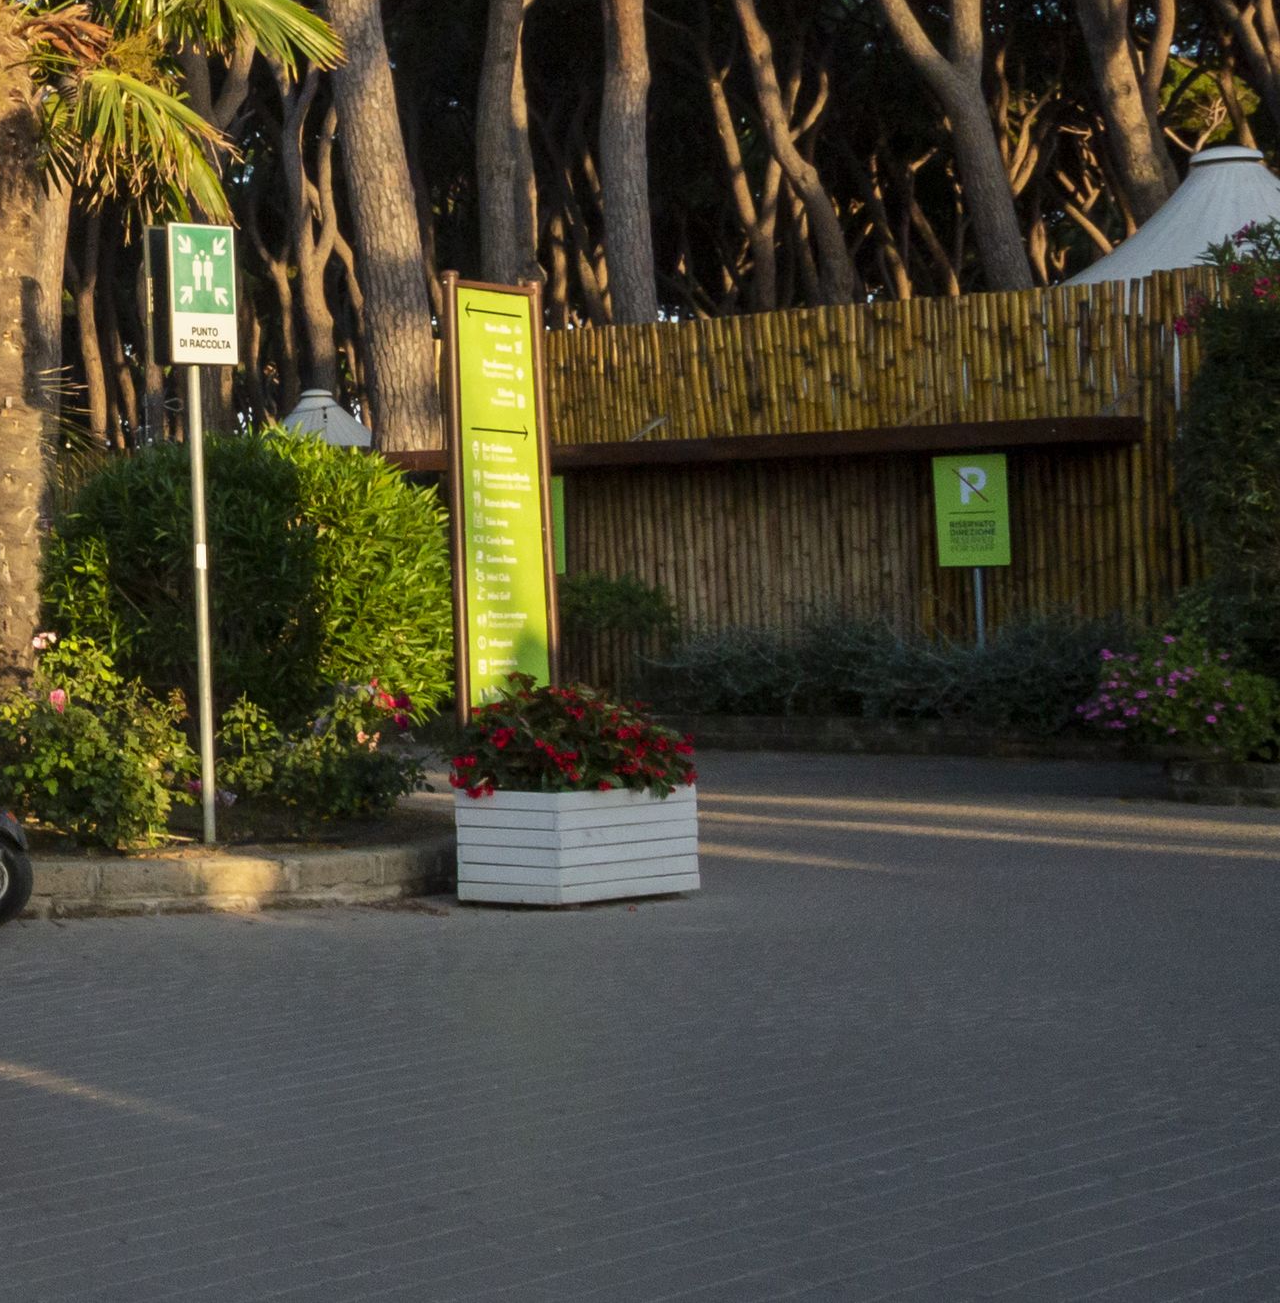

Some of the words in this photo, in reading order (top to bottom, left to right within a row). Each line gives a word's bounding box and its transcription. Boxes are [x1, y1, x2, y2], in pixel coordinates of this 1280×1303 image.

[192, 326, 218, 337] PUNTO
[180, 338, 188, 348] DI
[190, 339, 231, 349] RACCOLTA
[960, 467, 986, 505] P
[950, 528, 996, 536] DIREZIONE
